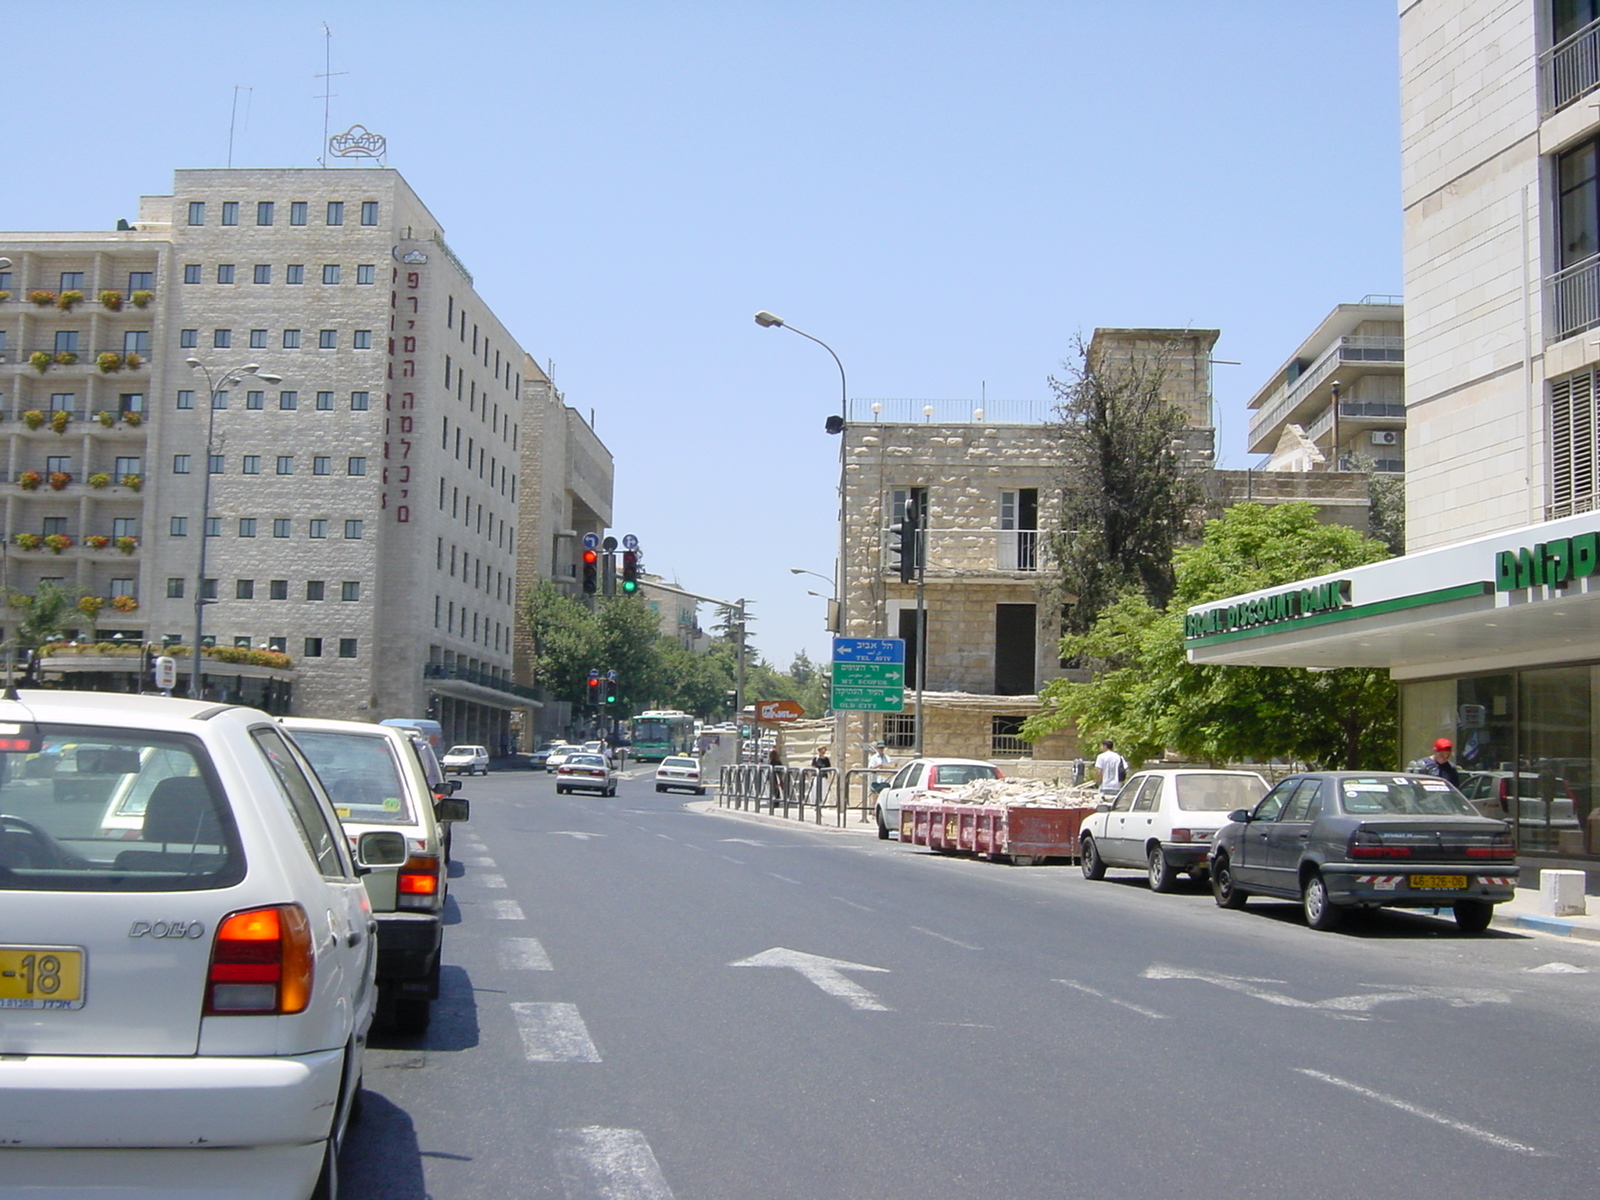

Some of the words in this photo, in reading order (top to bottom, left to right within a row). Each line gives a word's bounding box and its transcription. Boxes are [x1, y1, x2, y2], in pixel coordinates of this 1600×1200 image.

[403, 272, 419, 378] פרימה
[397, 392, 415, 523] המלכים
[1184, 608, 1226, 638] ISRAEL
[1227, 591, 1297, 627] DISCOUNT
[1300, 580, 1348, 612] BANK
[856, 642, 878, 650] אביב
[881, 640, 893, 650] תל
[128, 920, 205, 939] POLO
